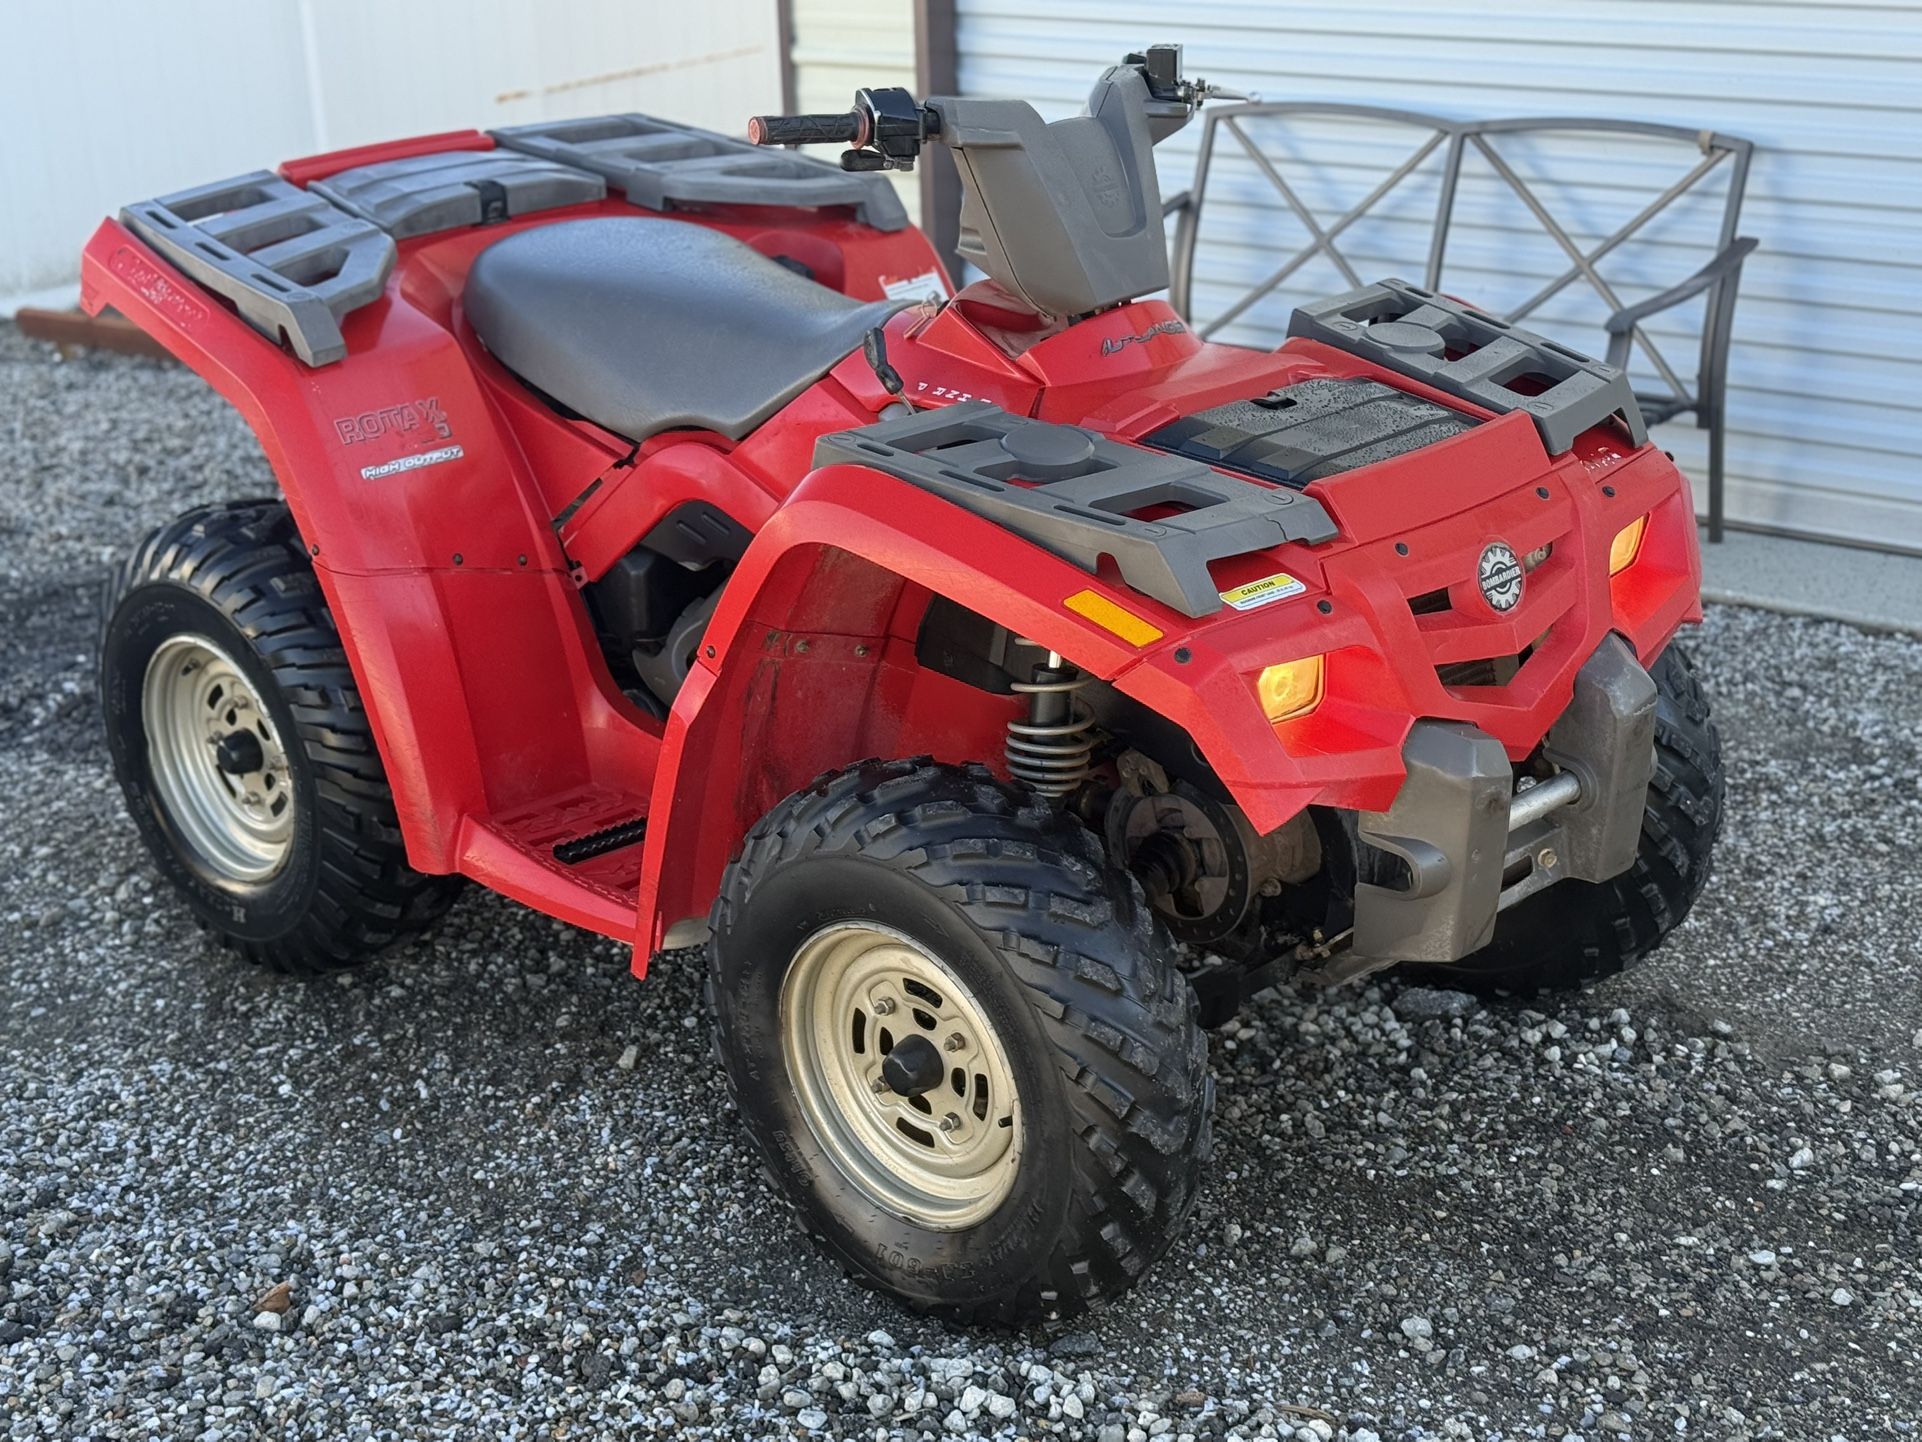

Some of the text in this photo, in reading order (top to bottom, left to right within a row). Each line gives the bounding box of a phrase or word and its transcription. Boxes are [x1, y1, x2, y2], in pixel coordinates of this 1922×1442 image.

[333, 396, 447, 445] ROTAX
[365, 447, 460, 478] HIGH OUTPUT
[1241, 580, 1275, 596] CAUTION
[1481, 566, 1521, 590] BOMBARDIER
